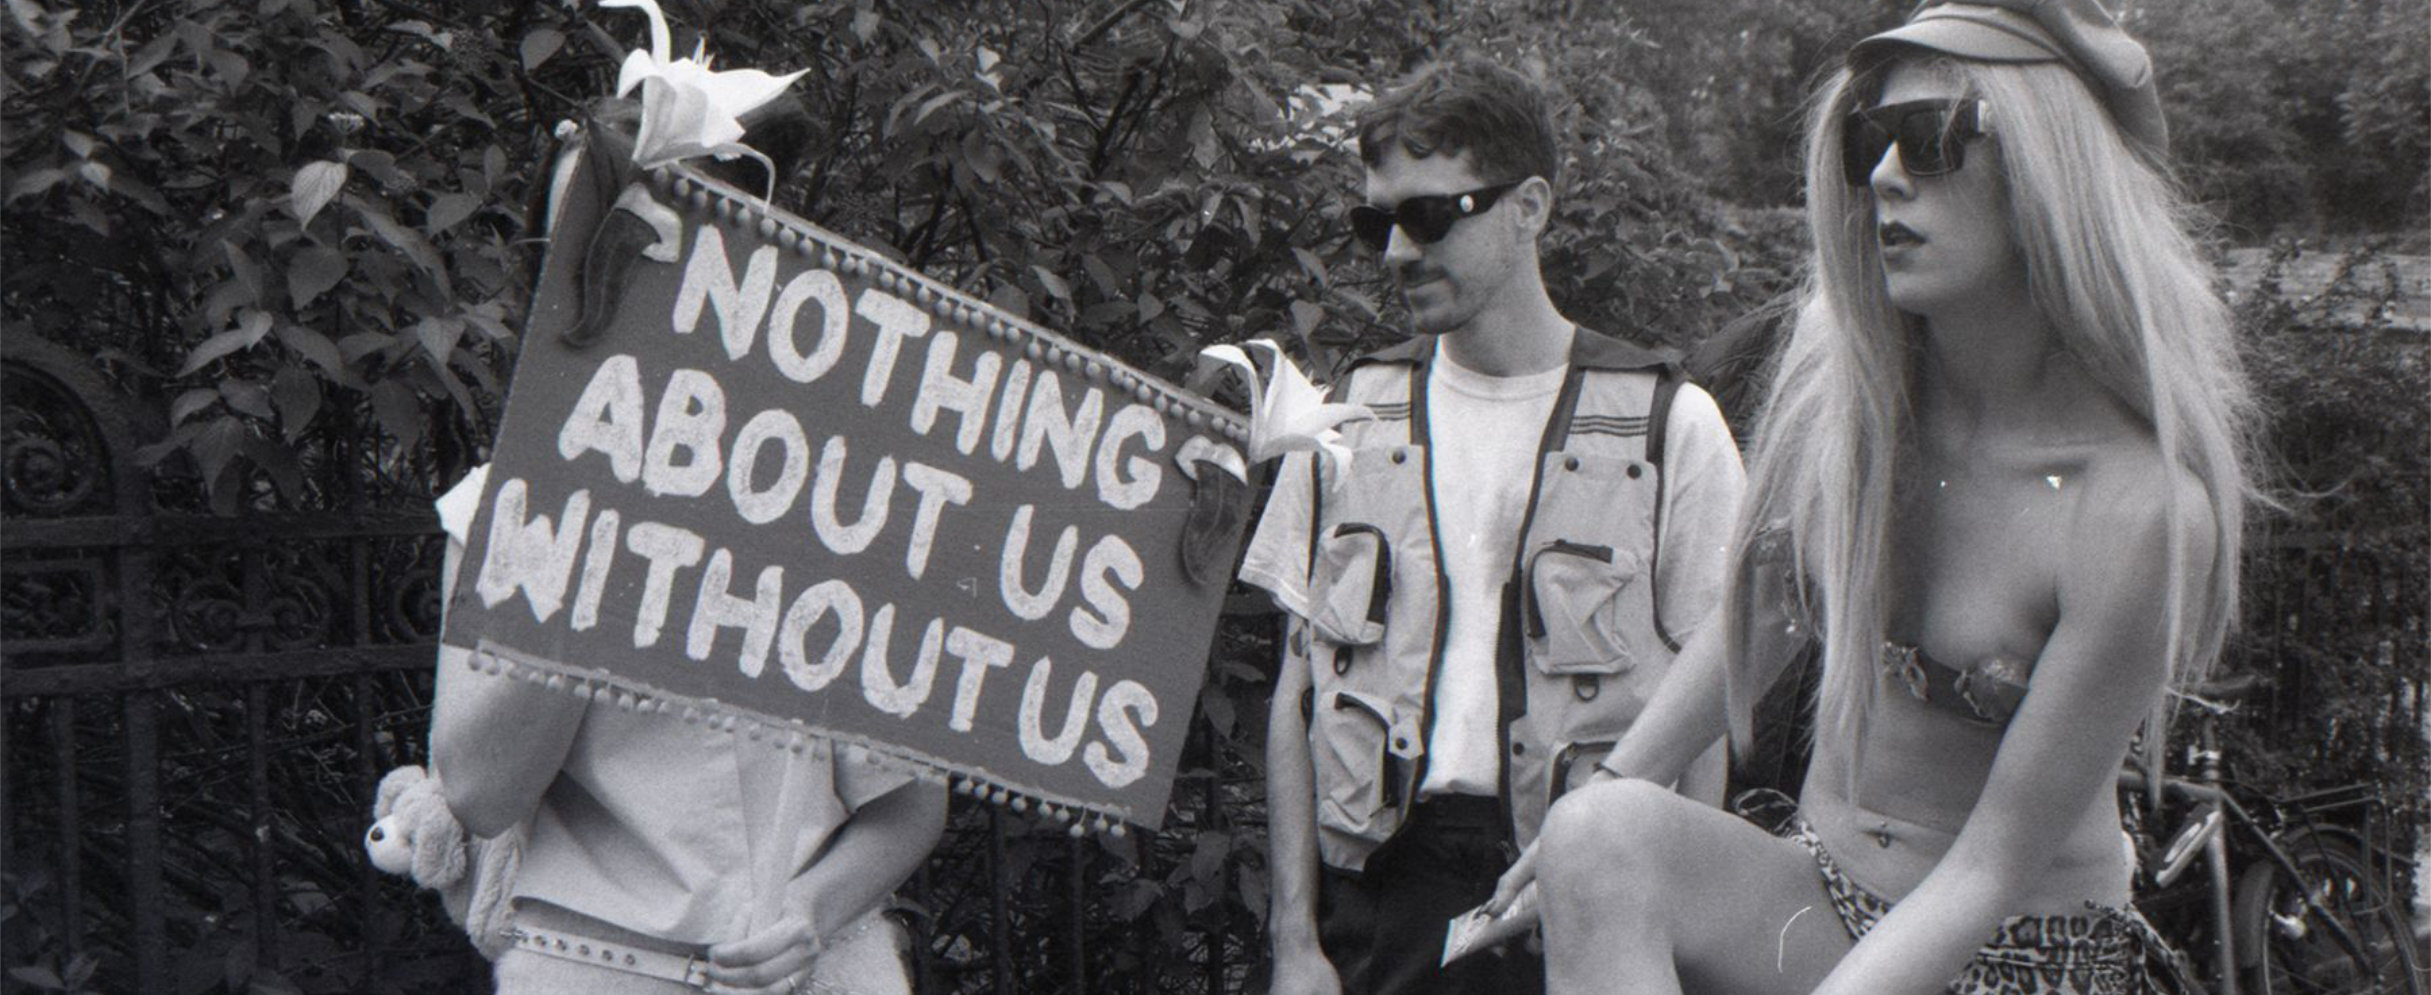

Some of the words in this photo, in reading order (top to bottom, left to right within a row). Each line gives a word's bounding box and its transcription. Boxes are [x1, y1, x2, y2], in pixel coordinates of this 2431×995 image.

[557, 353, 974, 580] ABOUT
[999, 503, 1145, 650] US
[672, 224, 1167, 511] NOTHING
[475, 477, 1015, 733] WITHOUT
[1017, 655, 1159, 789] US
